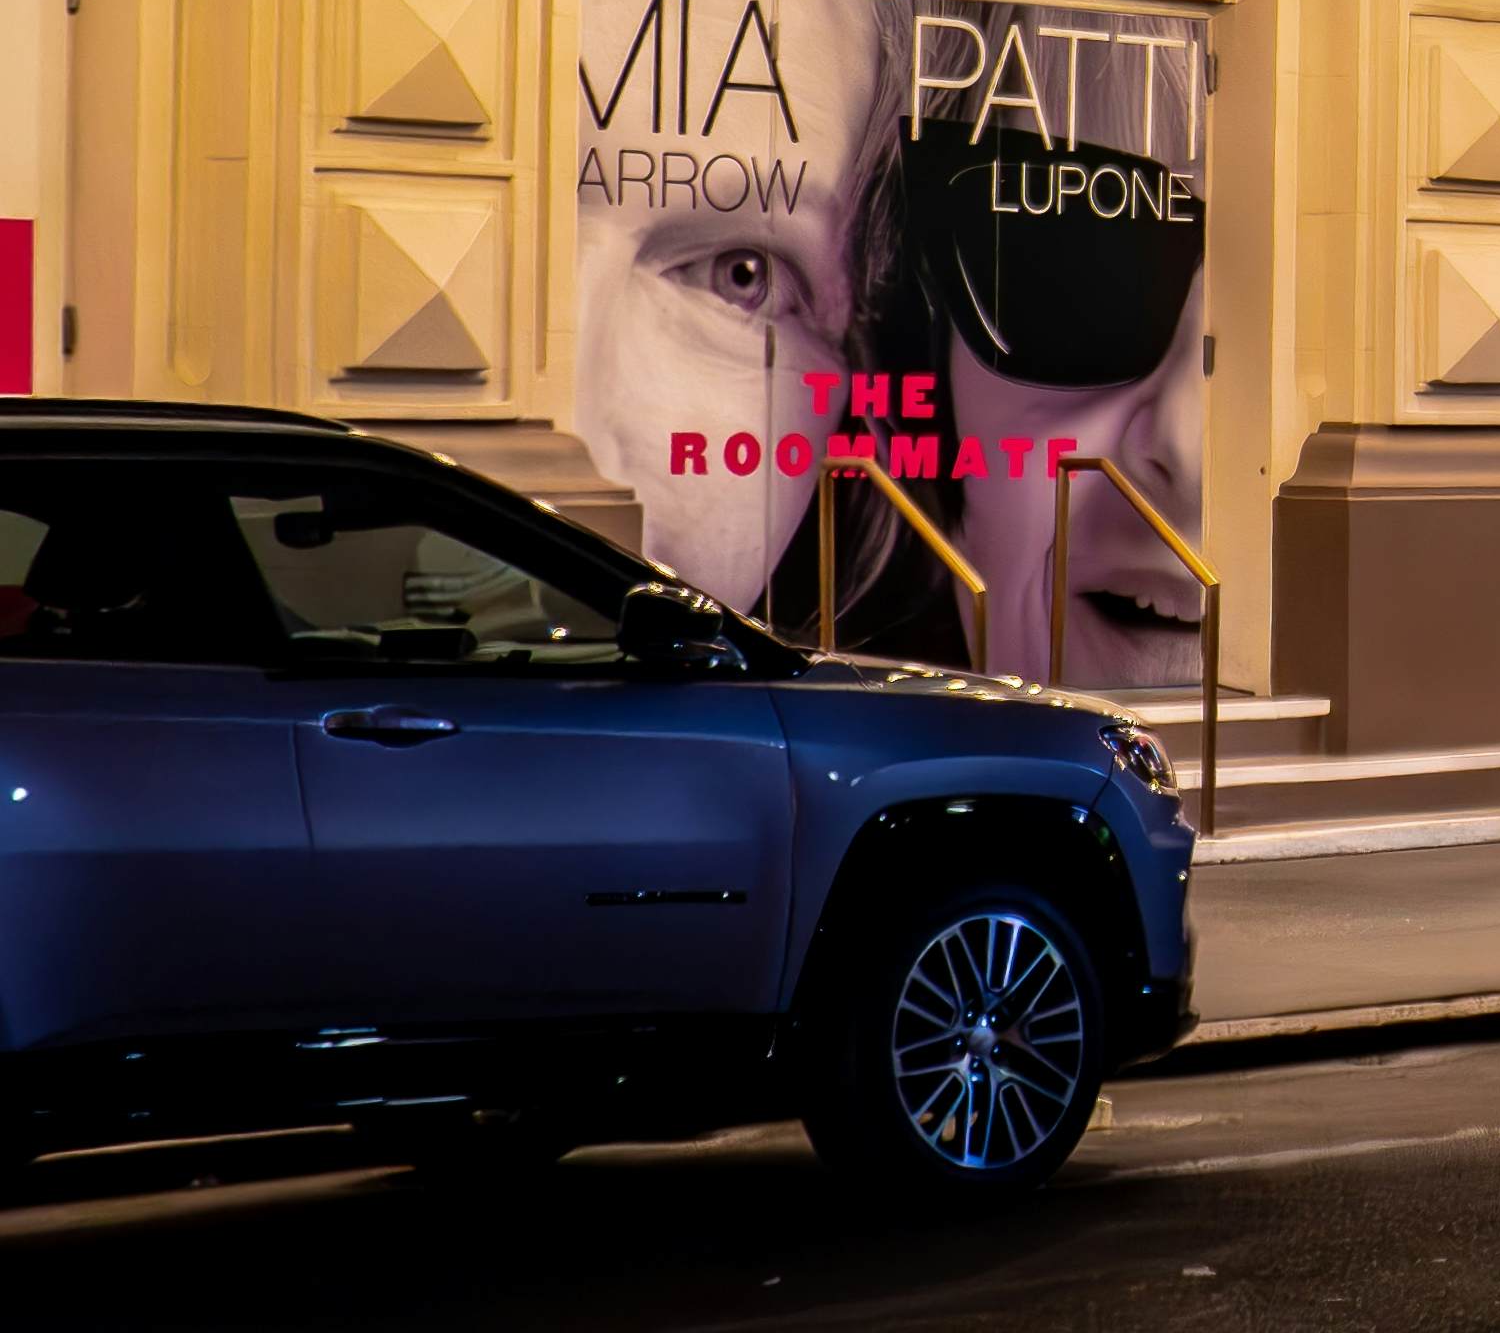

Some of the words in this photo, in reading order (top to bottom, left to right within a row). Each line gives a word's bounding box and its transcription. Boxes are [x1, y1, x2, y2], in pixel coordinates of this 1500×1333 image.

[911, 13, 1199, 161] PATTI
[577, 145, 808, 216] ARROW
[990, 158, 1195, 223] LUPONE
[801, 372, 936, 418] THE
[670, 431, 1079, 479] ROOMMATE
